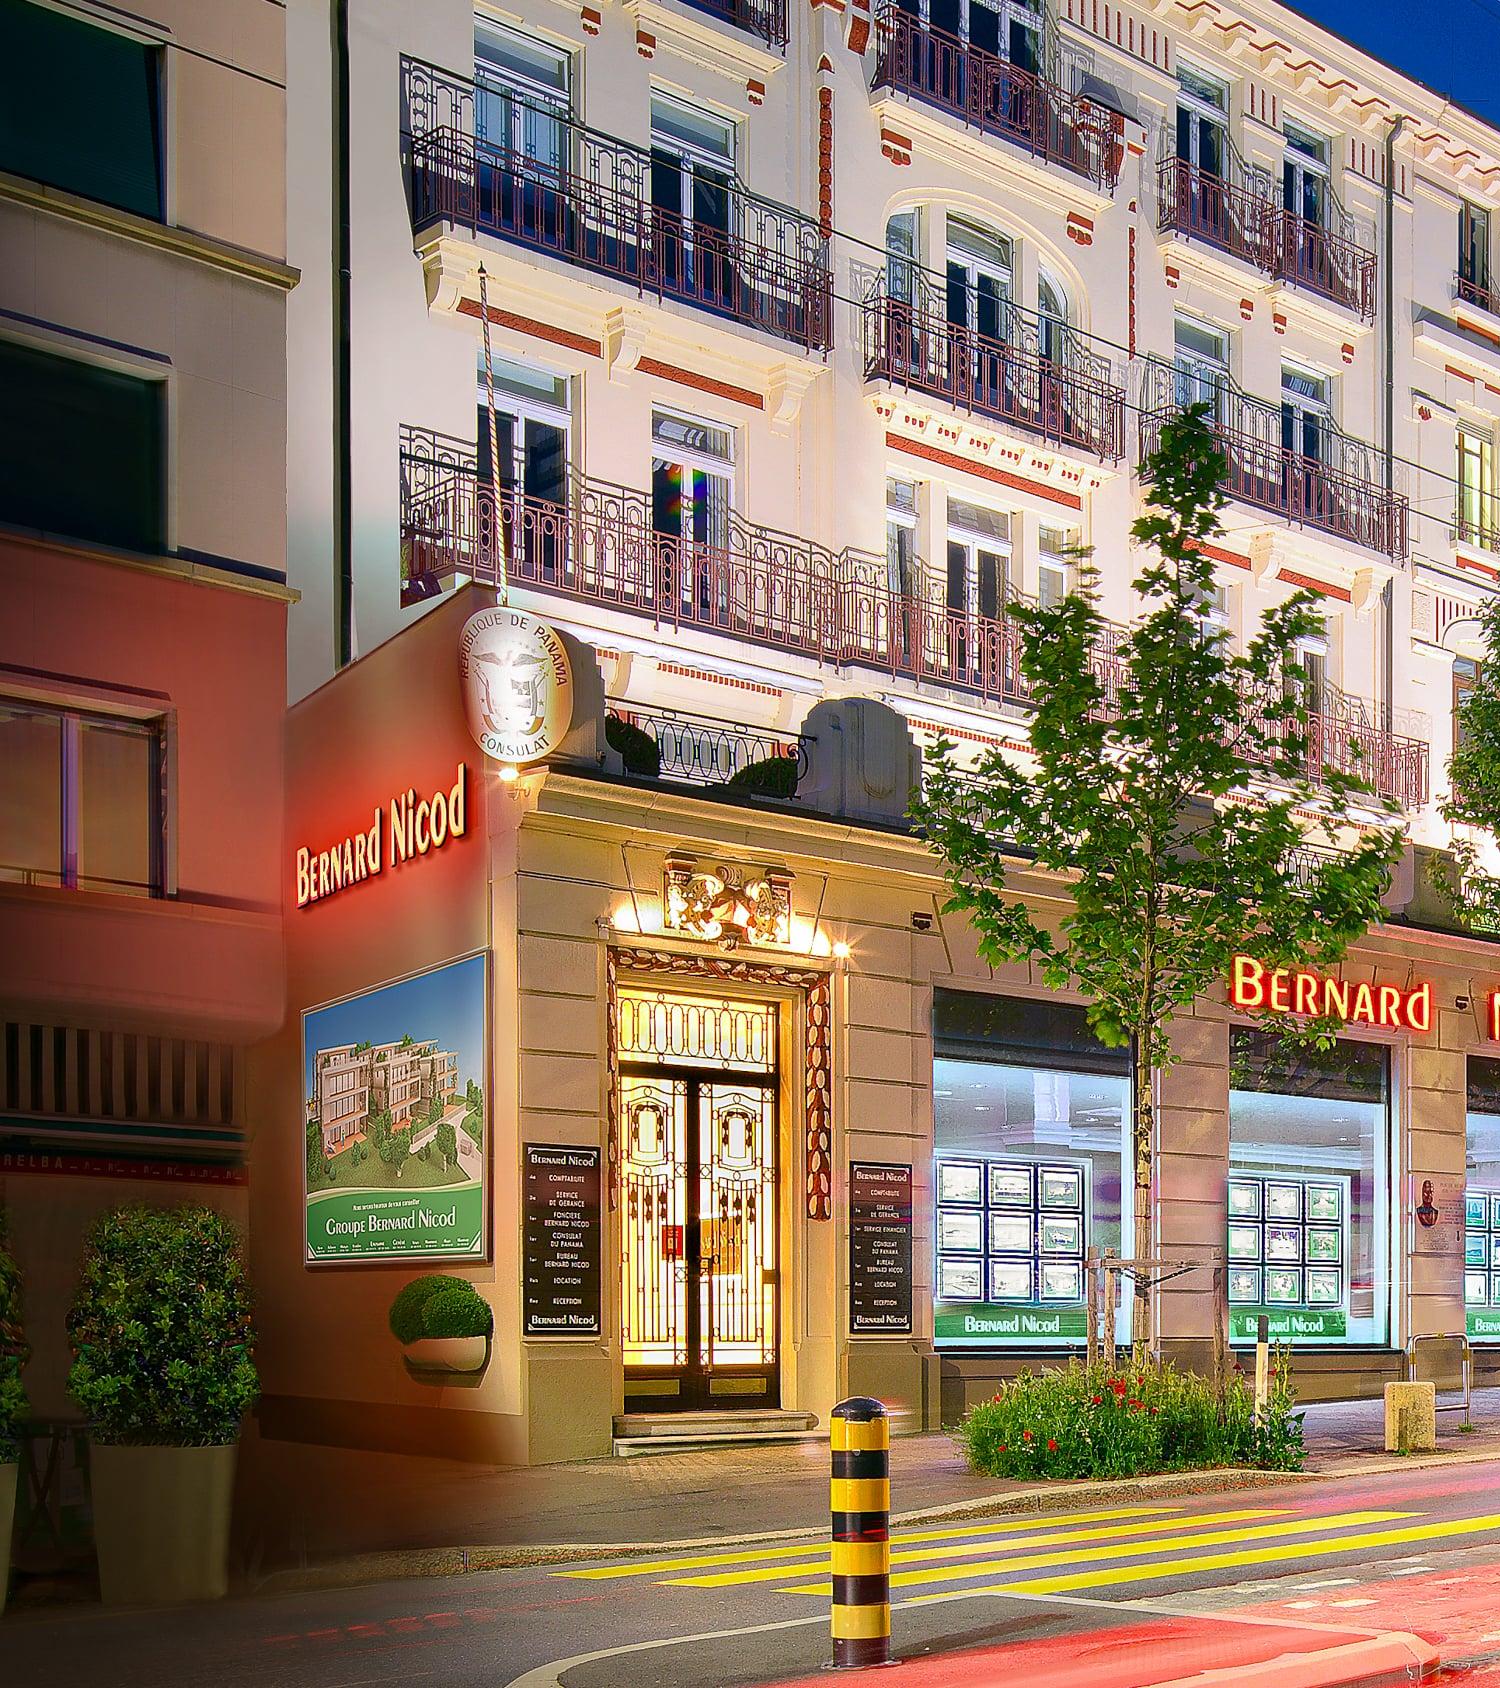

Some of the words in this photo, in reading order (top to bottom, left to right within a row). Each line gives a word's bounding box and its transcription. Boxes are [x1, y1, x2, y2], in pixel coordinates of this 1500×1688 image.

[510, 614, 529, 629] DE
[533, 625, 567, 687] PANAMA
[480, 733, 550, 756] CONSULAT
[391, 762, 466, 867] Nicod
[568, 1155, 594, 1167] Nicod
[418, 1206, 456, 1229] Nicod
[568, 1315, 595, 1325] Nicod
[1021, 1315, 1060, 1333] Nicod
[1292, 1316, 1324, 1333] Nicod
